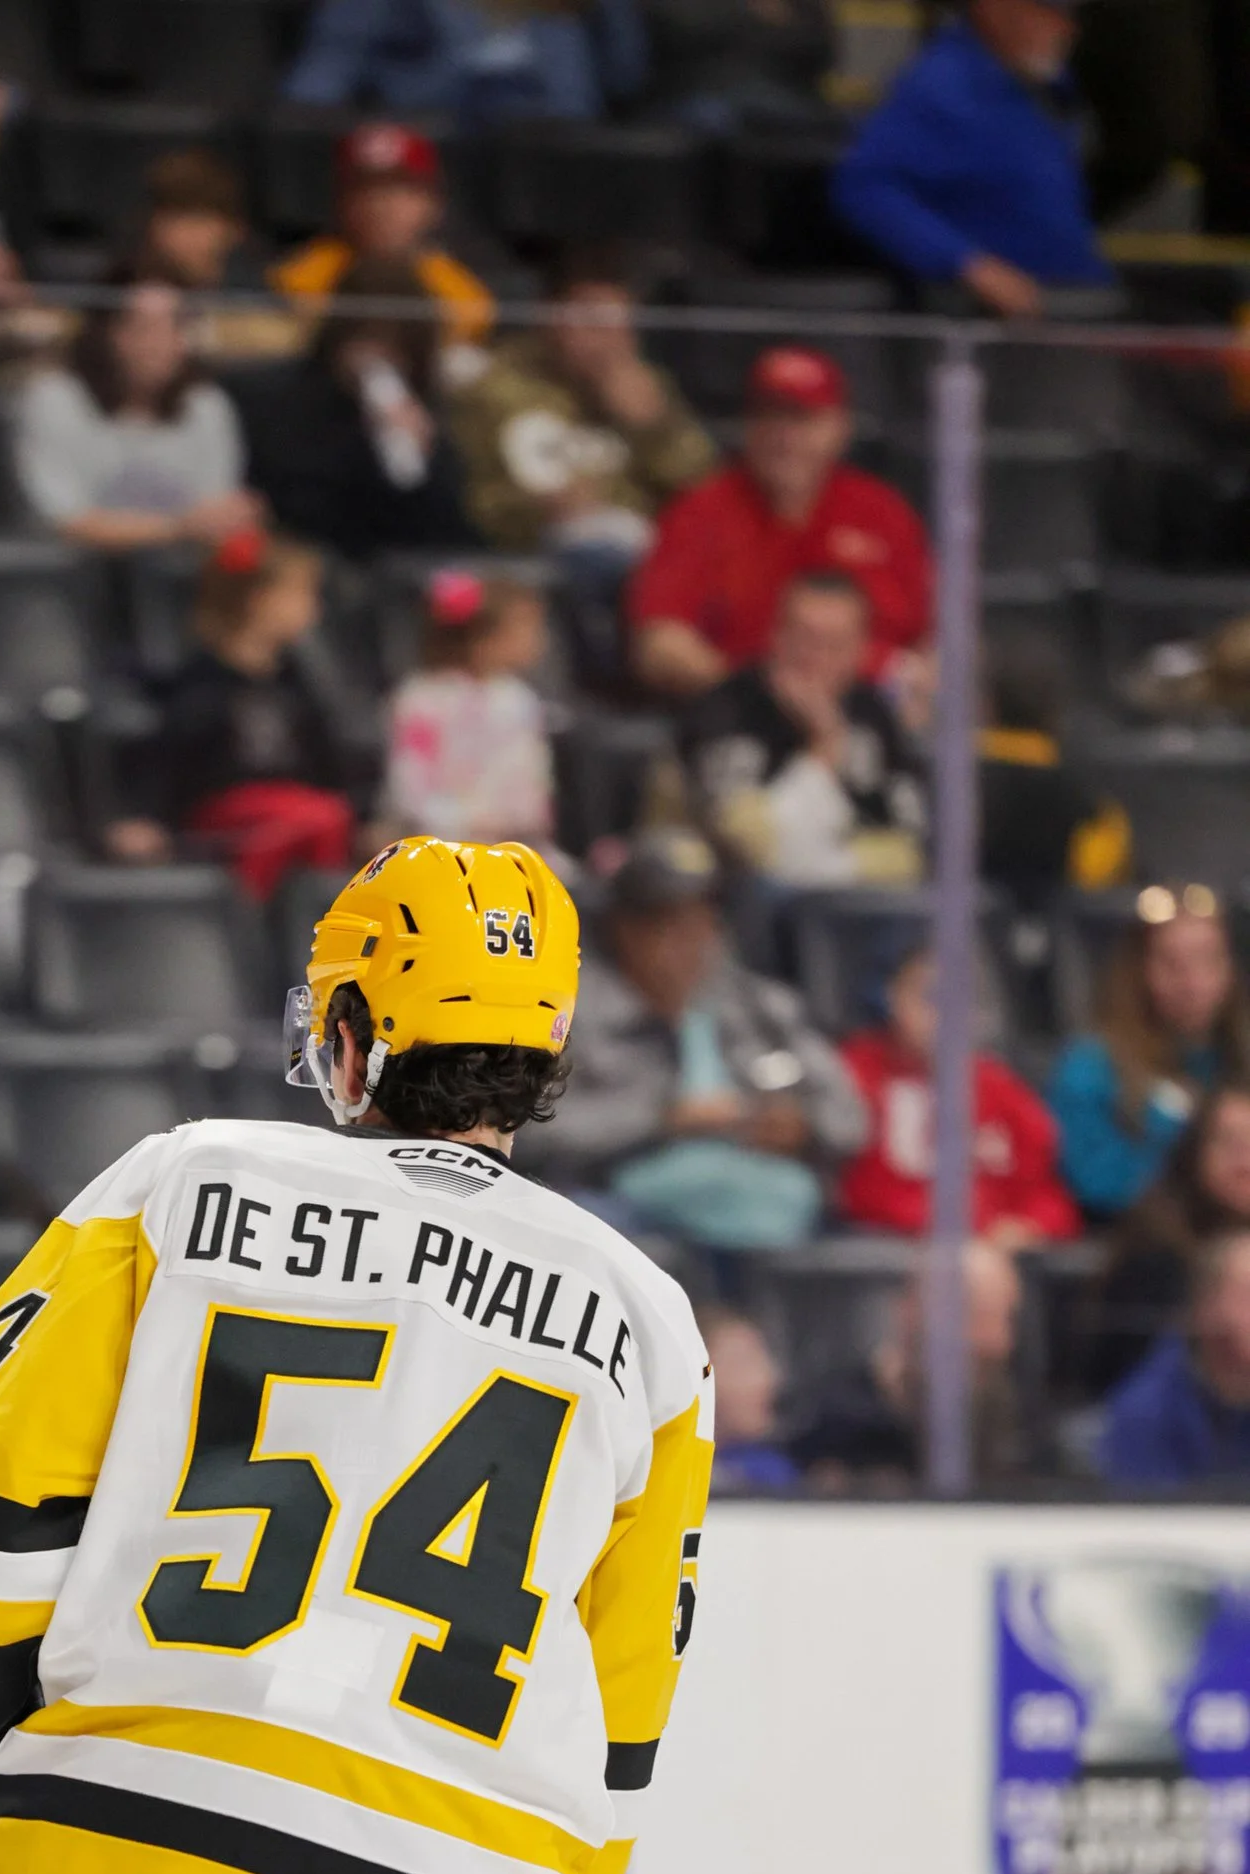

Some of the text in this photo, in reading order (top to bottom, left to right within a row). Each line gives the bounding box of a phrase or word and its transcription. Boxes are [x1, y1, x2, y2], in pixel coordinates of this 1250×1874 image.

[485, 910, 535, 959] 54
[387, 1147, 504, 1179] CCM
[183, 1182, 632, 1400] DE ST. PHALLE
[134, 1303, 580, 1751] 54
